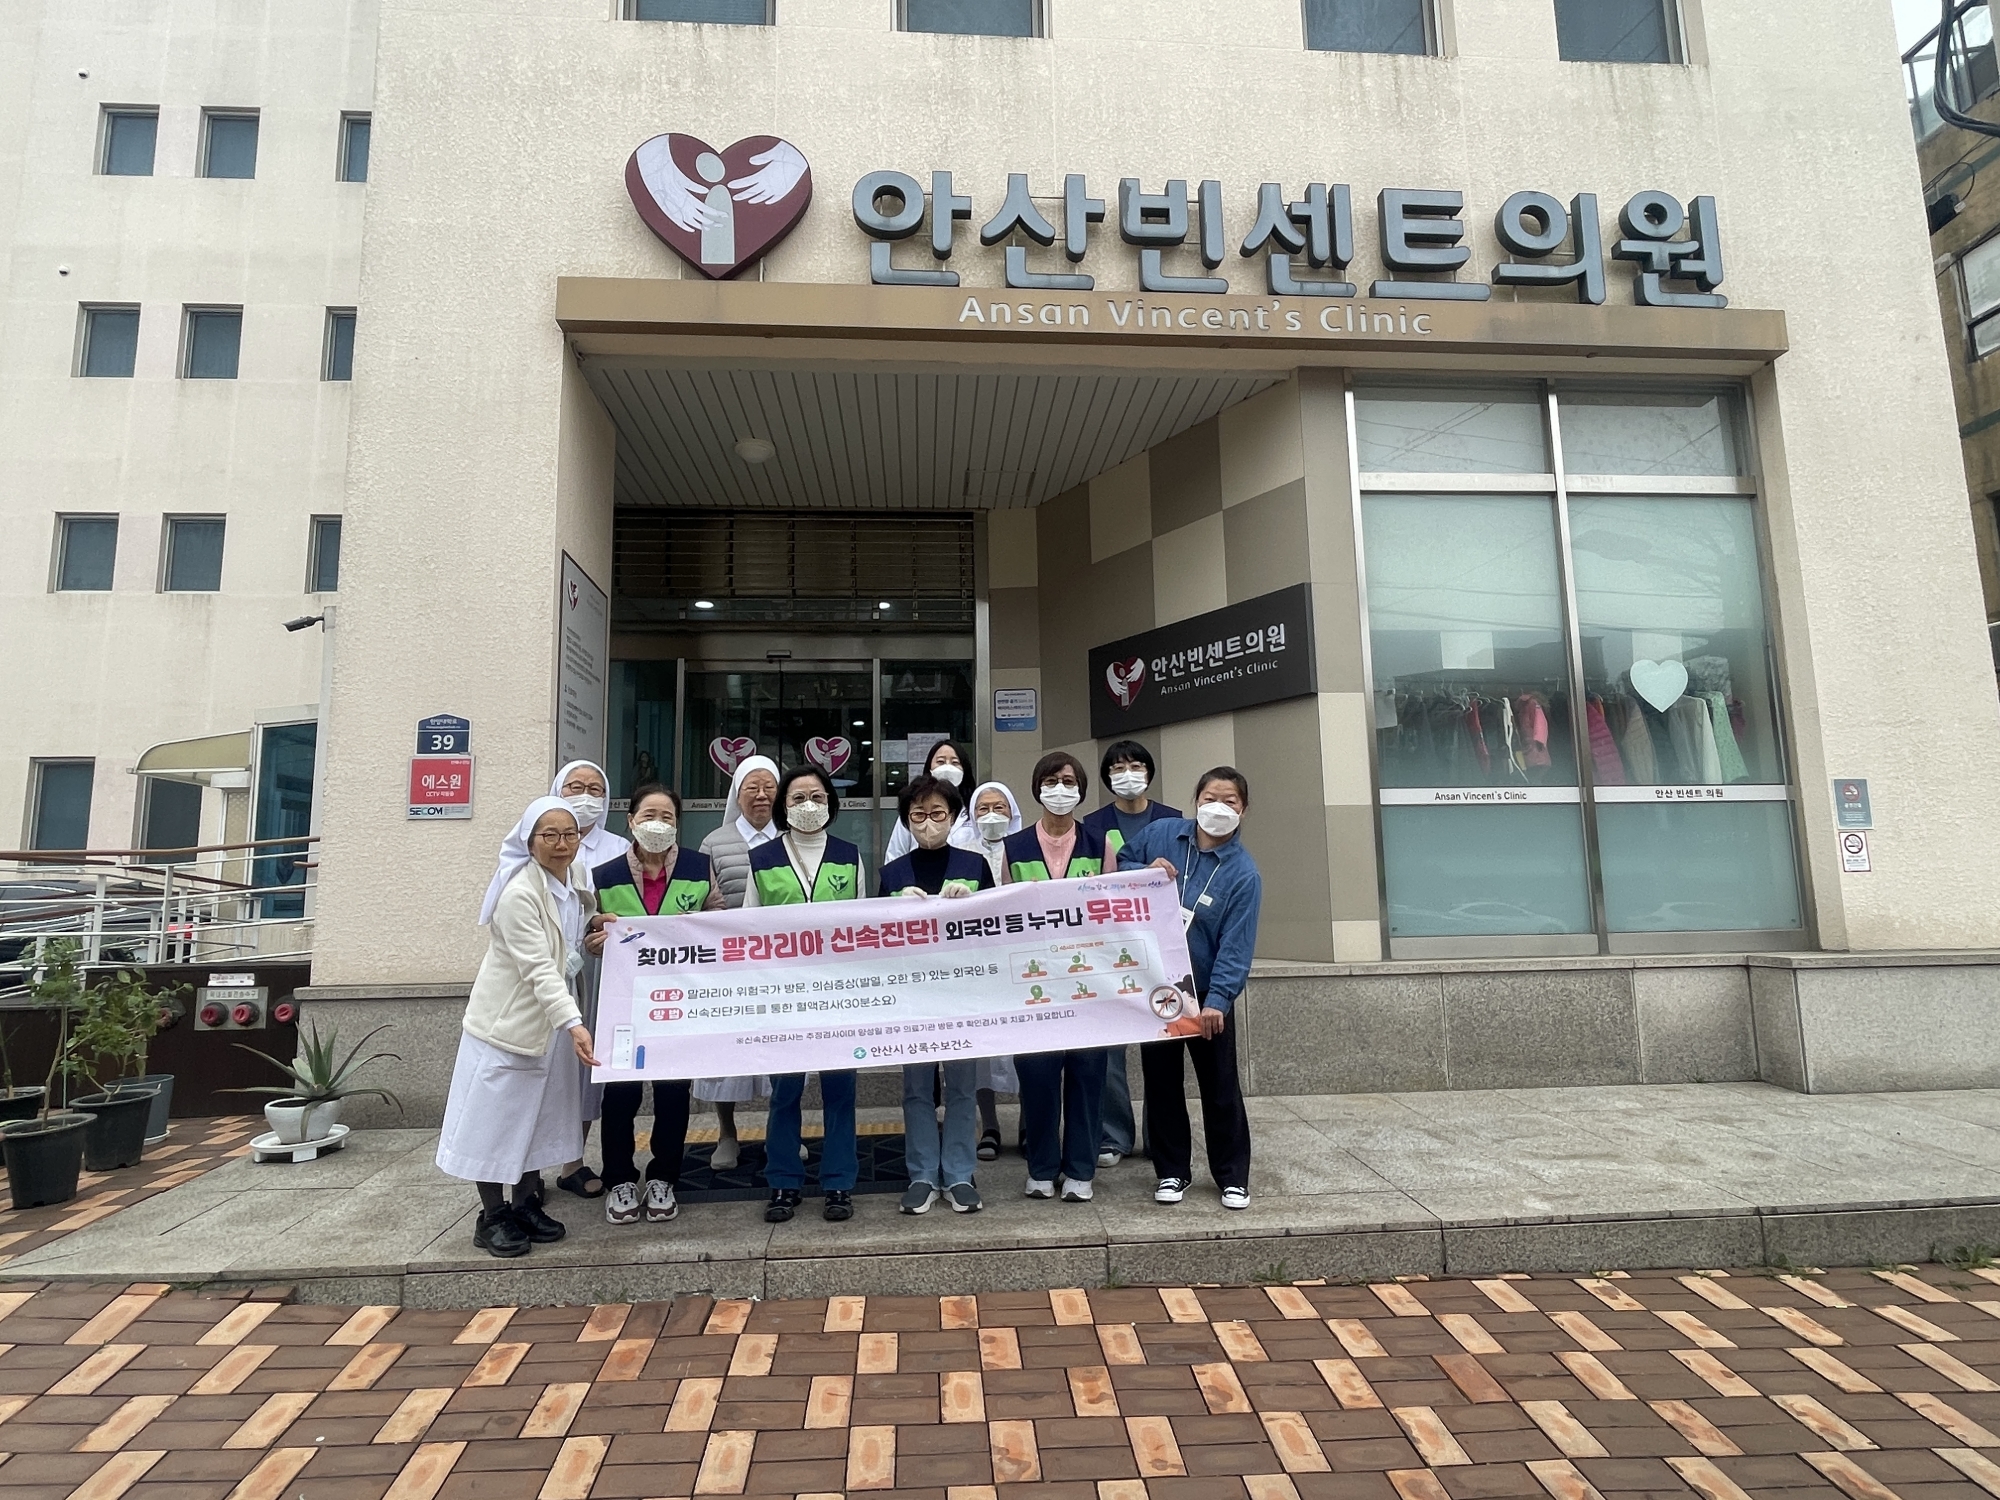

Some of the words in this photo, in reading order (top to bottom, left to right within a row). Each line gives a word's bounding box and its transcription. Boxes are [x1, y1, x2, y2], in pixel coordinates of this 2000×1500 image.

[852, 170, 1728, 309] 안산빈센트의원
[959, 296, 1090, 326] Ansan
[1106, 300, 1302, 331] Vincent's
[1319, 304, 1433, 335] Clinic
[1151, 623, 1286, 682] 안산빈센트의원
[1160, 682, 1191, 696] Ansan
[1193, 666, 1243, 687] Vincent's
[1246, 660, 1279, 675] Clinic
[431, 735, 455, 750] 39
[421, 774, 461, 789] 에스원
[1655, 789, 1673, 798] 안산
[1676, 789, 1703, 798] 빈센트
[1706, 788, 1723, 798] 의원
[1434, 792, 1461, 801] Ansan
[1462, 791, 1502, 800] Vincent's
[1504, 791, 1527, 800] Clinic
[409, 807, 443, 816] SECOM
[637, 944, 717, 967] 찾아가는
[722, 929, 824, 962] 말라리아
[831, 918, 939, 953] 신속진단!
[945, 916, 1002, 940] 외국인
[1005, 913, 1024, 934] 등
[1027, 907, 1083, 930] 누구나
[1086, 897, 1151, 925] 무료!!
[687, 987, 733, 1000] 말라리아
[736, 984, 781, 997] 위험국가
[784, 982, 810, 994] 방문,
[887, 973, 908, 985] 오한
[911, 971, 926, 984] 등)
[929, 969, 950, 981] 있는
[953, 965, 985, 979] 외국인
[987, 963, 999, 975] 등
[687, 1004, 767, 1019] 신속진단키트를
[770, 1003, 793, 1014] 통한
[796, 995, 897, 1013] 혈액검사(30분소요)
[806, 1029, 856, 1040] 추정검사이며
[858, 1026, 883, 1036] 양성일
[885, 1025, 901, 1034] 경우
[903, 1022, 935, 1033] 의료기관
[938, 1021, 954, 1031] 방문
[956, 1021, 964, 1029] 후
[966, 1018, 998, 1028] 확인검사
[1000, 1016, 1008, 1025] 및
[1010, 1014, 1034, 1024] 치료가
[1036, 1010, 1077, 1021] 필요합니다.
[870, 1044, 904, 1058] 안산시
[907, 1039, 973, 1054] 상록수보건소
